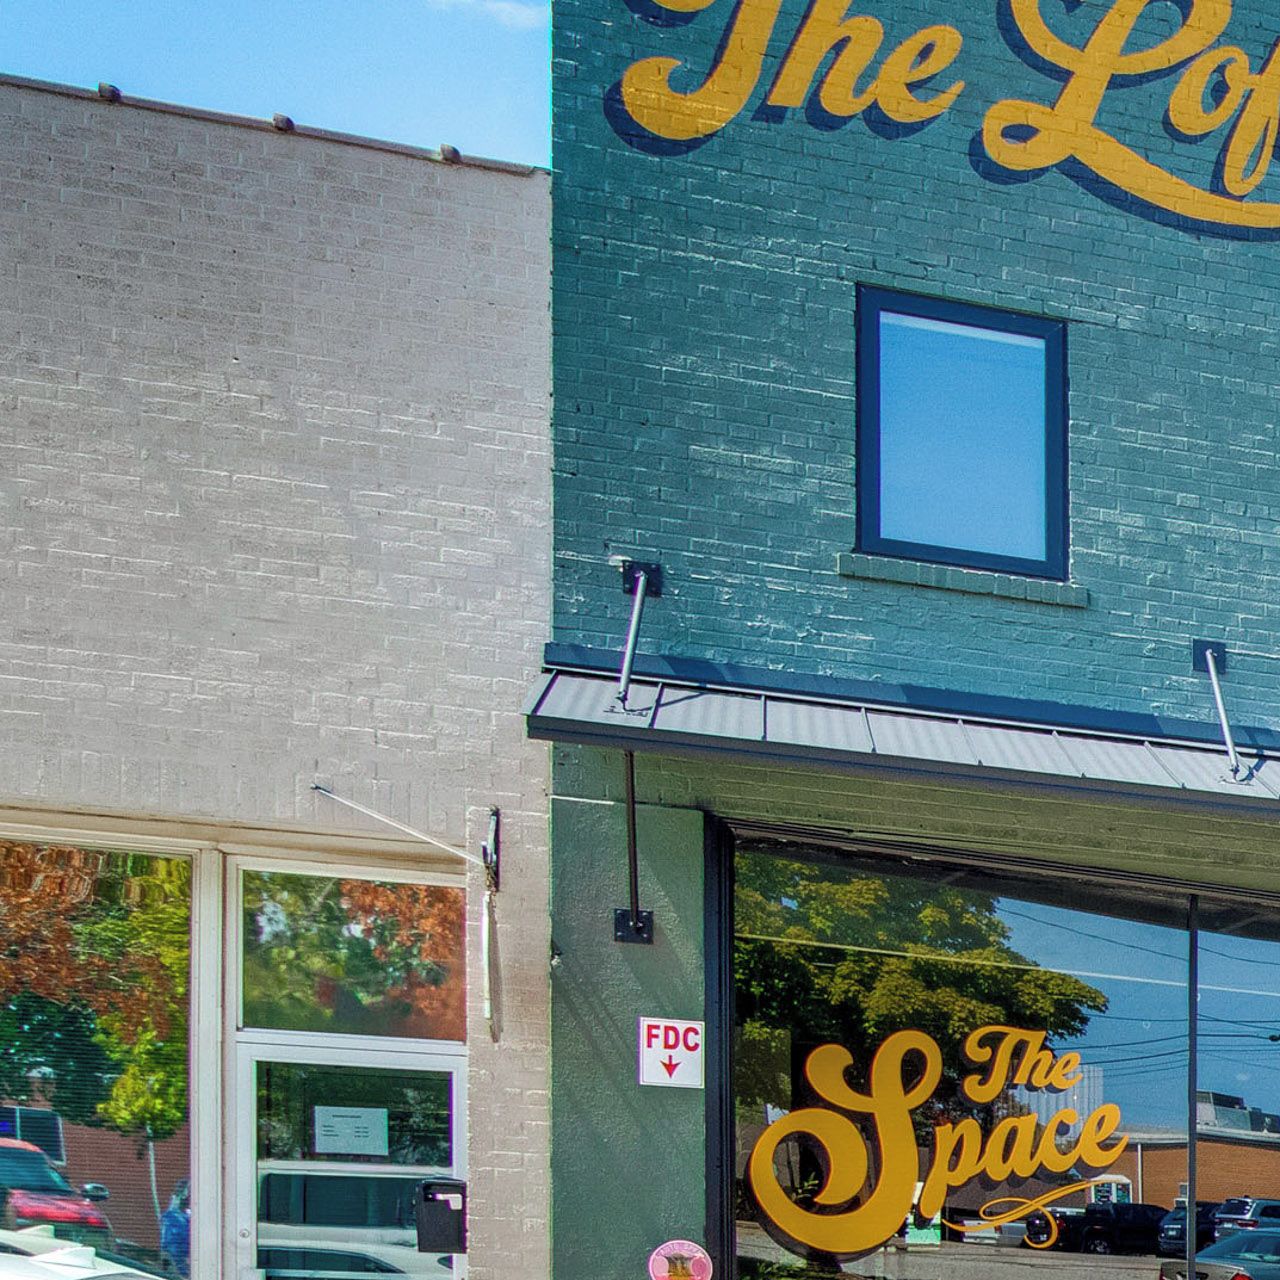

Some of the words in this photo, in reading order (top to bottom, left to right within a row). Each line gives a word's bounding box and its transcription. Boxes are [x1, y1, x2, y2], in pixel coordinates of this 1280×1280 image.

[608, 0, 966, 148] The
[645, 1024, 701, 1052] FDC
[963, 1025, 1083, 1103] The
[750, 1030, 1130, 1253] Space
